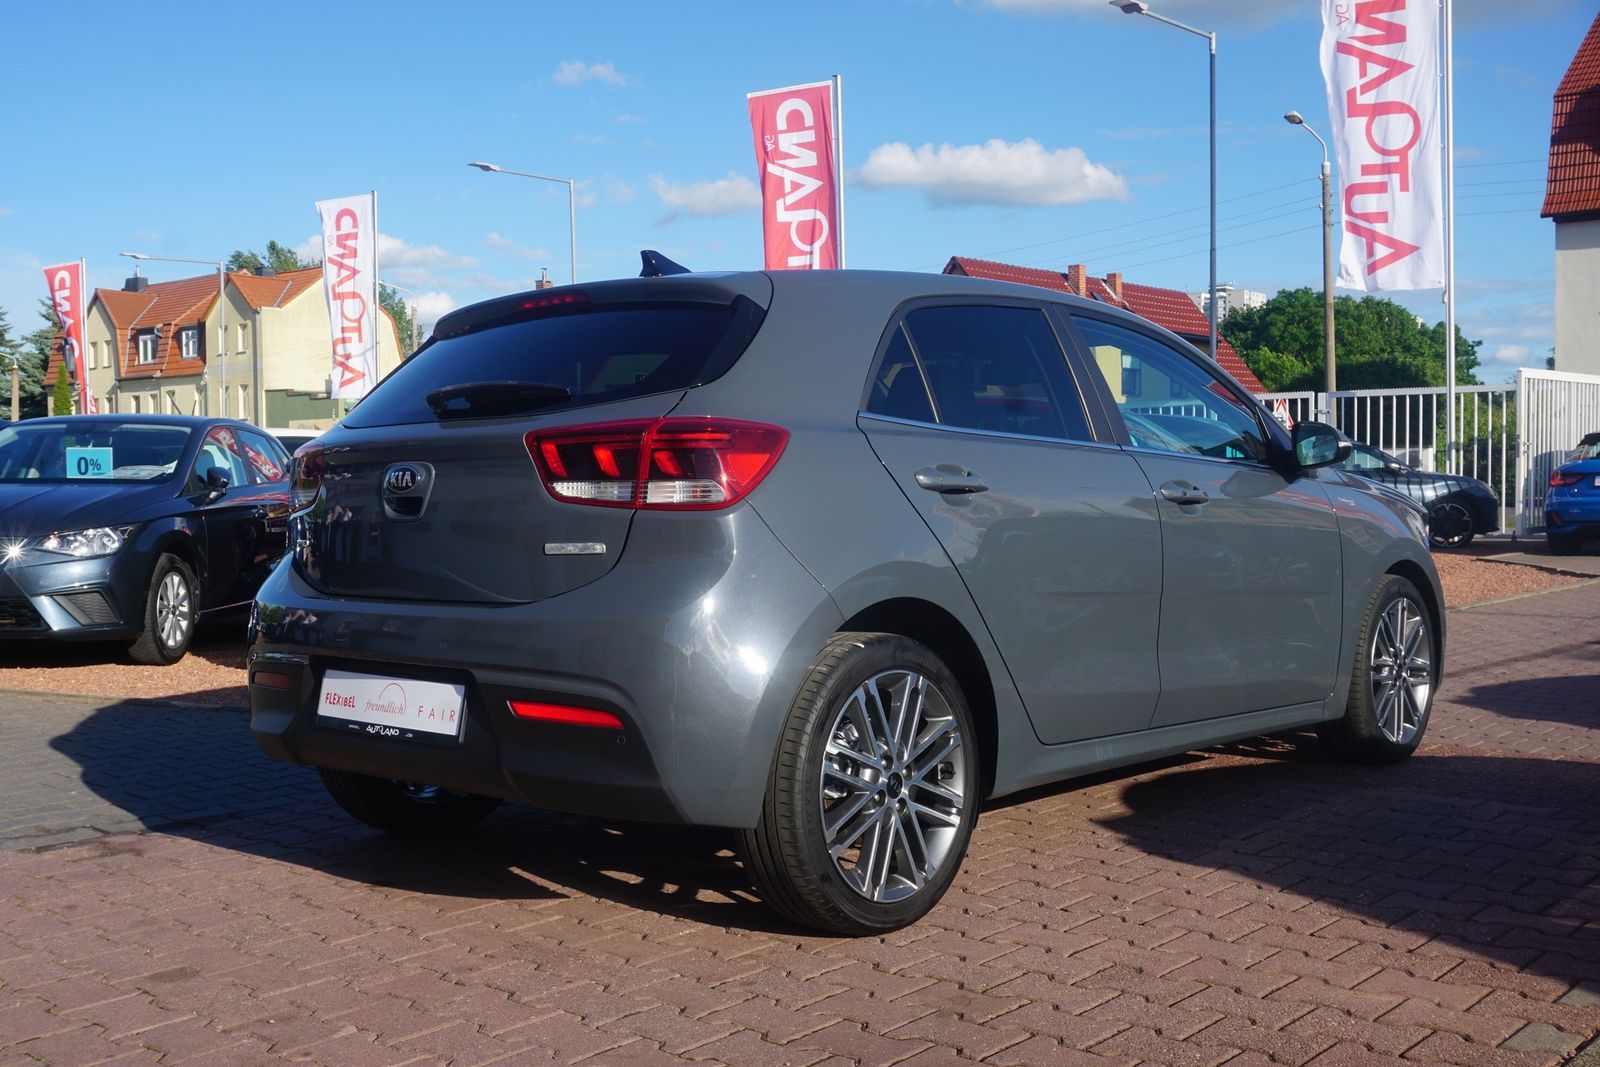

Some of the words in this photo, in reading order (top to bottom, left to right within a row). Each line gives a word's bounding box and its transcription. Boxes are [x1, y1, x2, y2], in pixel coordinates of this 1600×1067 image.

[76, 456, 102, 476] 0%
[390, 471, 412, 487] KIA
[325, 692, 356, 708] FLEXIBEL
[366, 724, 400, 736] AUTOLAND
